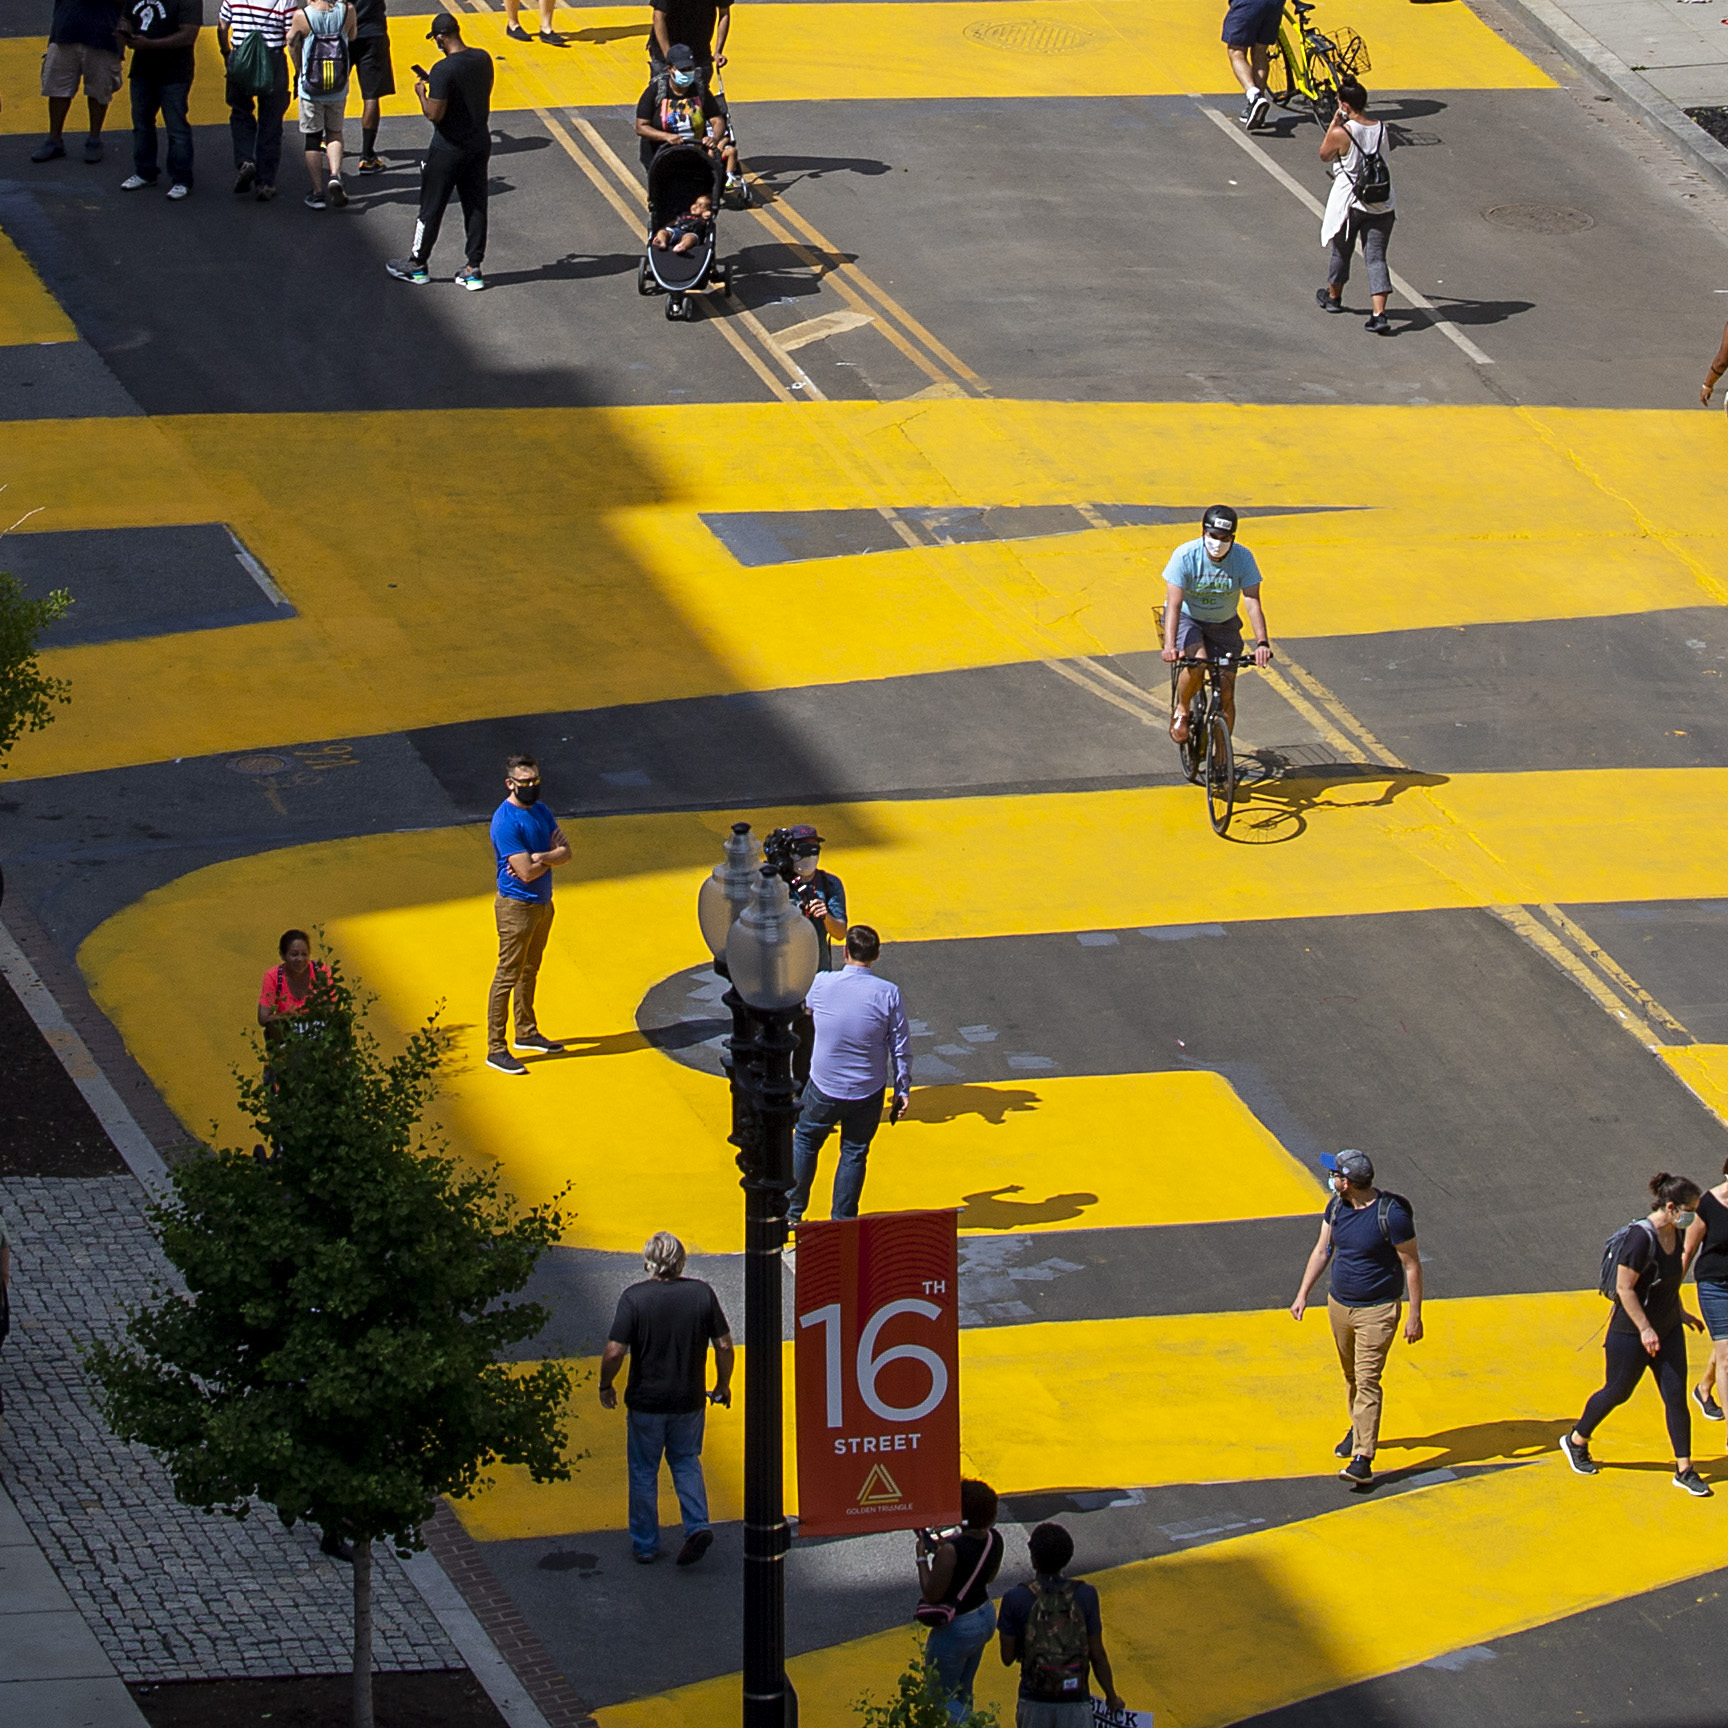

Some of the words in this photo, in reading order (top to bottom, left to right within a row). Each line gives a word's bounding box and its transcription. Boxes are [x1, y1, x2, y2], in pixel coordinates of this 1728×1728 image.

[922, 1280, 946, 1295] TH
[799, 1298, 948, 1427] 16
[834, 1433, 921, 1454] STREET
[846, 1505, 876, 1515] GOLDEN
[878, 1502, 914, 1513] TRIANGLE
